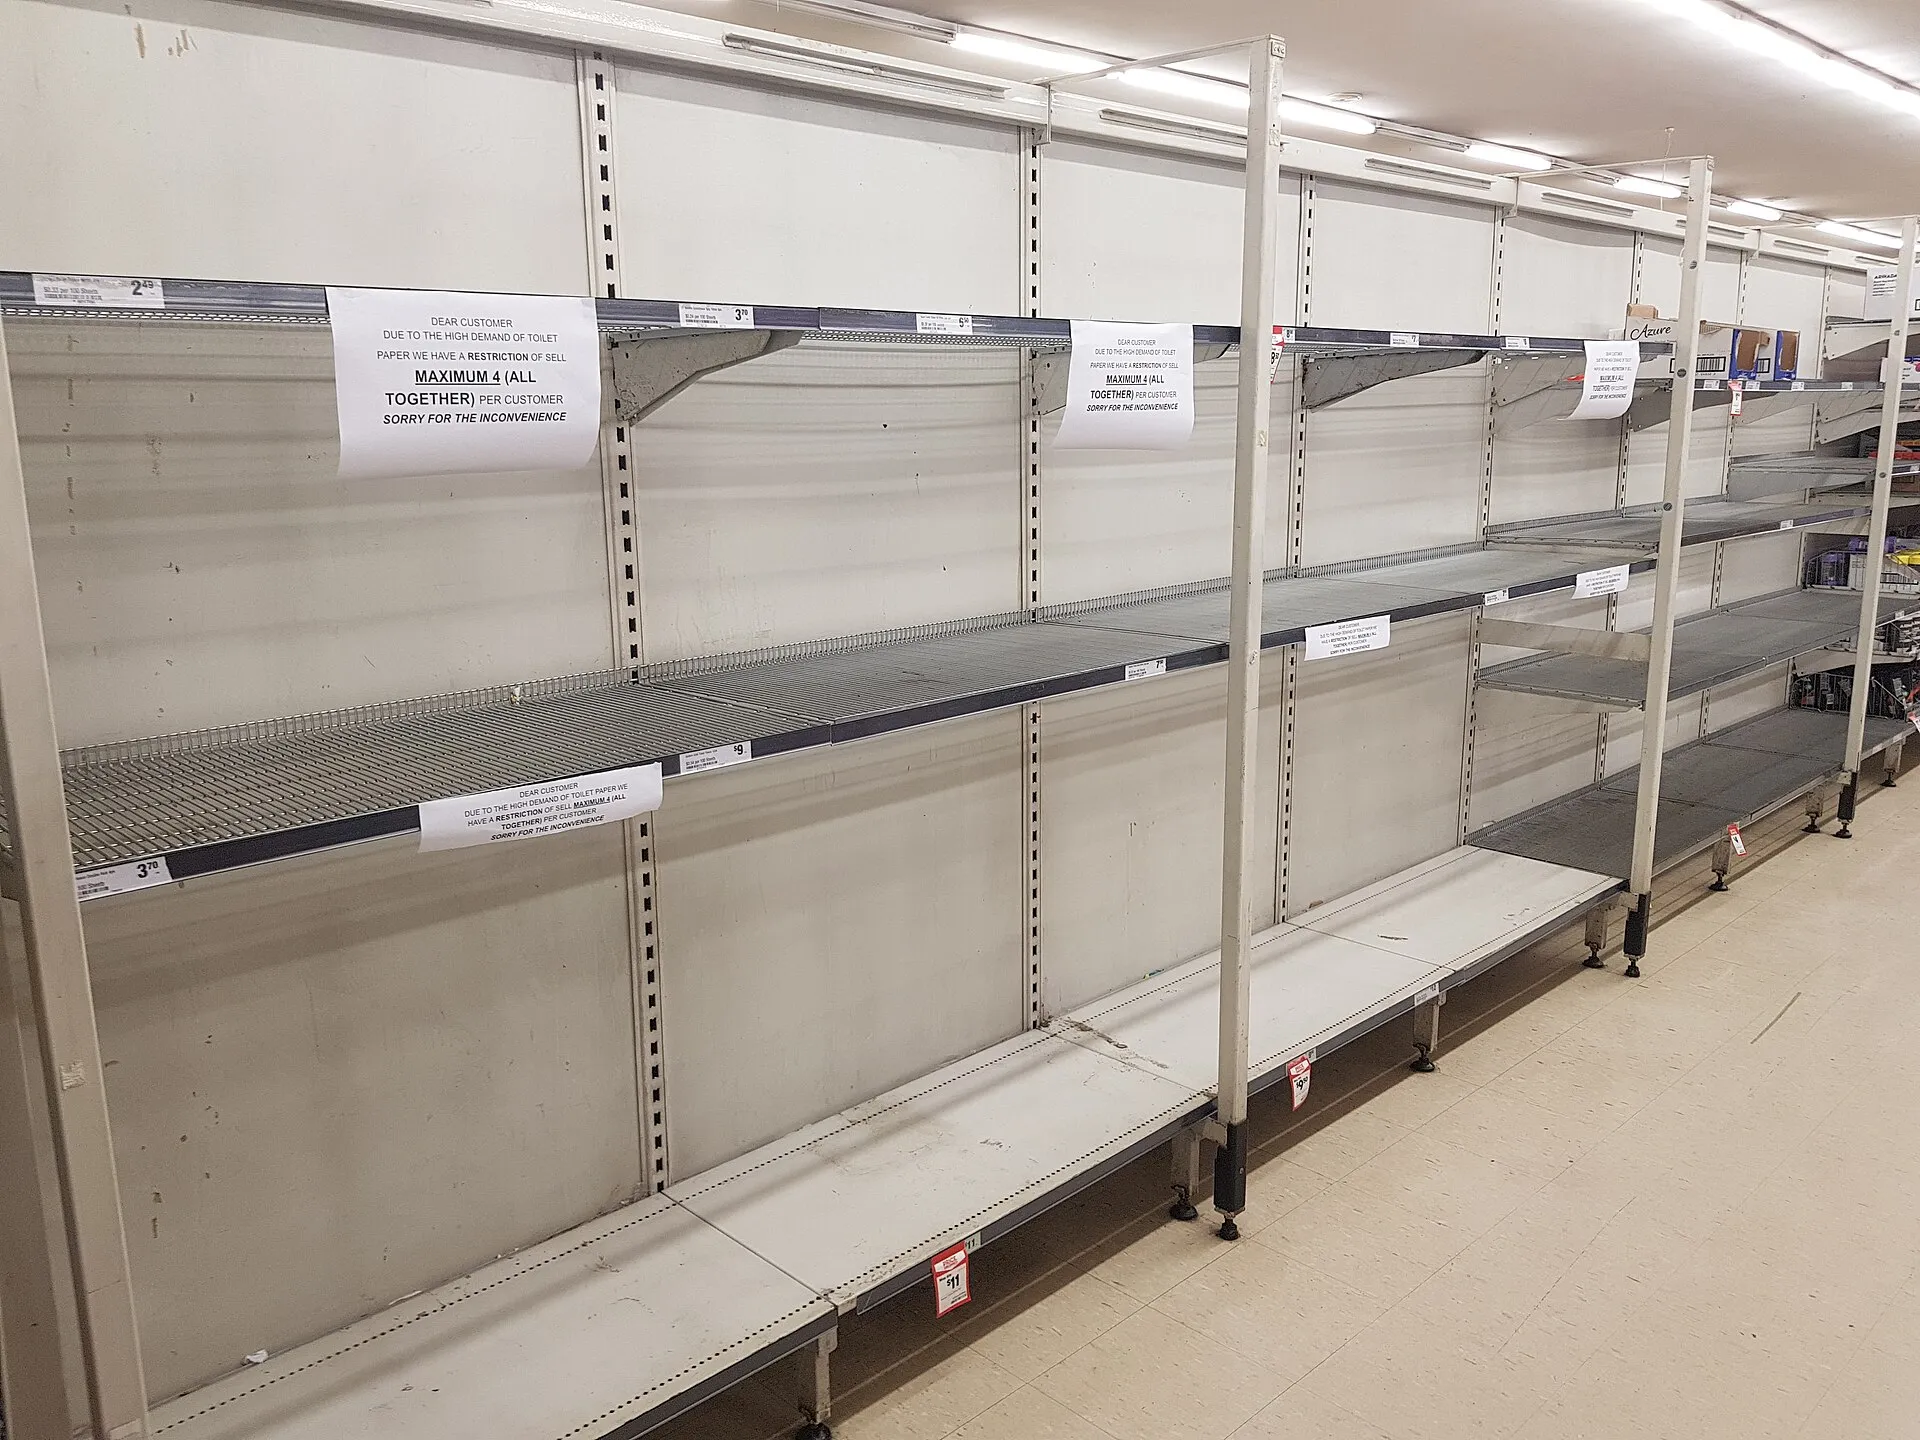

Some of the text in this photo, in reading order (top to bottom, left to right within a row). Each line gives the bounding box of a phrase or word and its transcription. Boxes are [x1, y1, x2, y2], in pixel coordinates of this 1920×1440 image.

[431, 317, 513, 327] DEAR CUSTOMER
[384, 330, 404, 339] DUE
[407, 331, 420, 339] TO
[423, 332, 442, 340] THE
[445, 332, 469, 340] HIGH
[471, 332, 510, 341] DEMAND
[528, 334, 558, 342] TOILET
[1630, 324, 1671, 340] Azure
[377, 351, 410, 360] PAPER
[412, 352, 428, 360] WE
[431, 352, 456, 360] HAVE
[459, 352, 465, 360] A
[468, 353, 529, 361] RESTRICTION
[415, 370, 536, 385] MAXIMUM 4 (ALL
[1106, 375, 1164, 385] MAXIMUM 4 (ALL
[385, 392, 563, 407] TOGETHER) PER CUSTOMER
[1091, 390, 1134, 400] TOGETHER)
[383, 412, 566, 424] SORRY FOR THE INCONVENIENCE
[734, 744, 743, 755] $9
[520, 783, 578, 798] DEAR CUSTOMER
[465, 809, 480, 817] DUE
[510, 801, 527, 809] HIGH
[529, 796, 558, 806] DEMAND
[571, 790, 594, 798] TOILET
[595, 786, 616, 794] PAPER
[468, 818, 487, 826] HAVE
[496, 808, 543, 821] RESTRICTION
[574, 798, 604, 809] MAXIMUM
[501, 818, 542, 830] TOGETHER)
[559, 808, 597, 819] CUSTOMER
[491, 831, 517, 840] SORRY
[550, 815, 604, 830] INCONVENIENCE
[947, 1274, 959, 1289] $11
